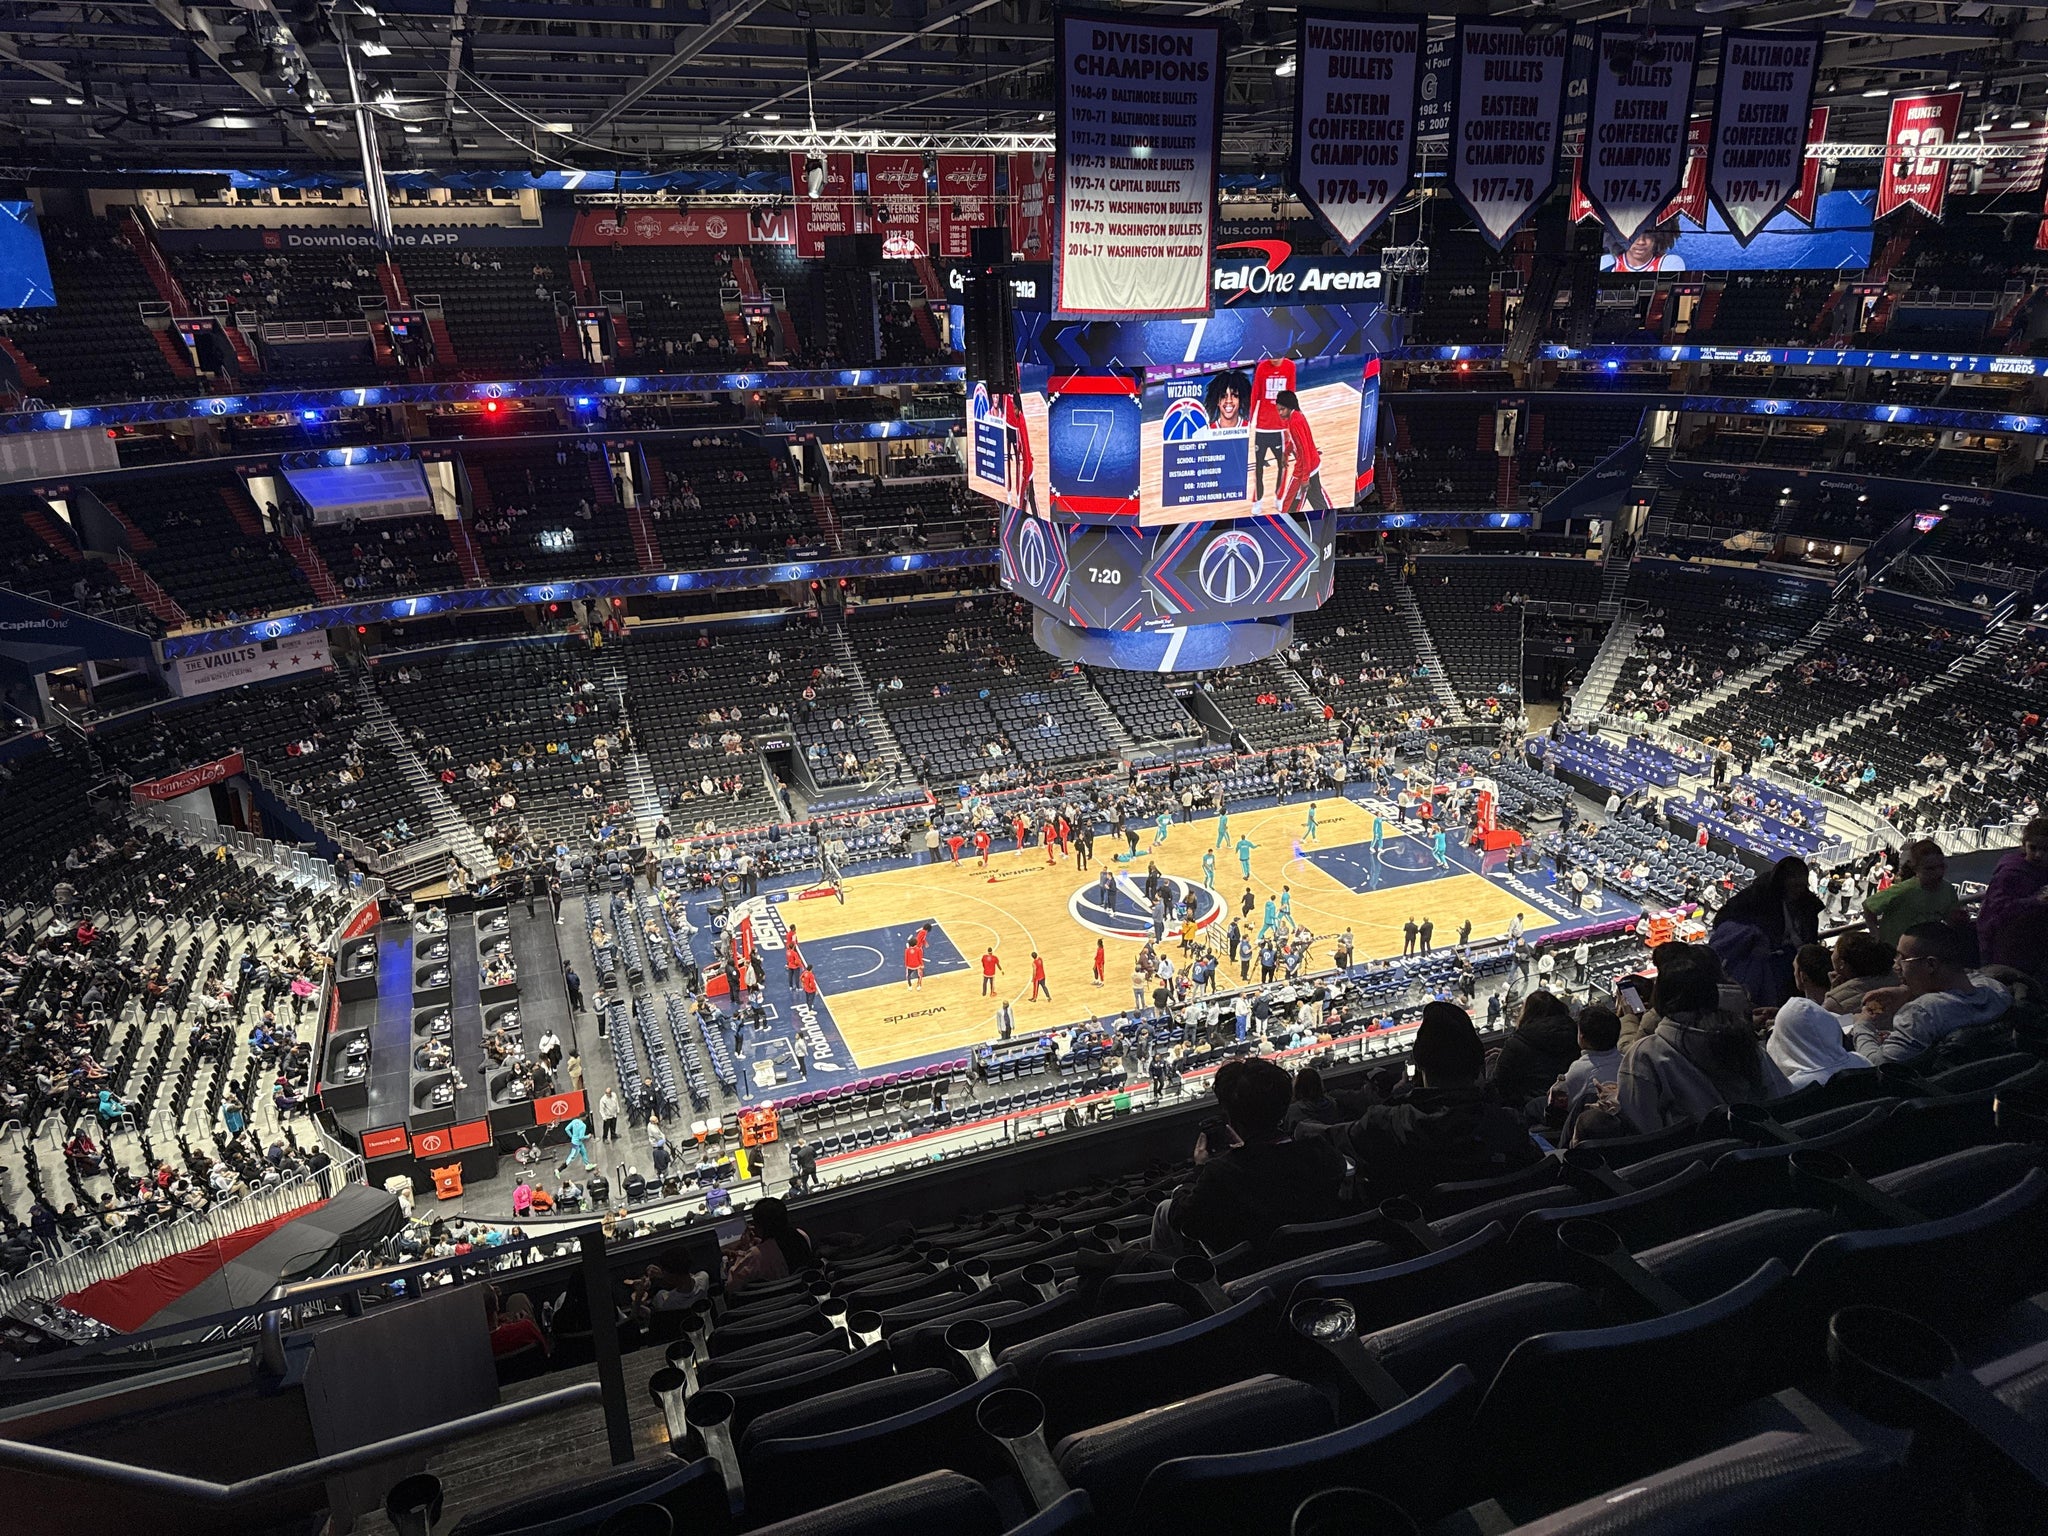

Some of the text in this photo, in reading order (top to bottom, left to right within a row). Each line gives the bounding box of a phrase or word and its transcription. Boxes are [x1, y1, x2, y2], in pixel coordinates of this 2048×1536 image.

[1092, 30, 1193, 57] DIVISION
[1307, 25, 1417, 53] WASHINGTON
[1427, 41, 1444, 55] CAA
[1465, 32, 1565, 57] WASHINGTON
[1731, 44, 1811, 67] WASHINGTON
[1074, 54, 1209, 81] CHAMPIONS
[1328, 56, 1393, 80] BULLETS
[1484, 60, 1543, 82] BULLETS
[1742, 70, 1794, 92] BULLETS
[1071, 84, 1197, 105] 1968-69 BALTIMORE BULLETS
[1326, 92, 1390, 115] EASTERN
[1419, 102, 1438, 116] 1982
[1481, 95, 1538, 116] EASTERN
[1614, 100, 1668, 121] EASTERN
[1738, 103, 1789, 123] EASTERN
[1907, 105, 1942, 120] HUNTER
[1071, 107, 1197, 127] 1970-71 BALTIMORE BULLETS
[1430, 116, 1450, 130] 2007
[1308, 118, 1404, 140] CONFERENCE
[1465, 120, 1551, 142] CONFERENCE
[1599, 123, 1679, 144] CONFERENCE
[1723, 126, 1798, 145] CONFERENCE
[1071, 130, 1196, 149] 1971-72 BALTIMORE BULLETS
[1311, 143, 1398, 166] CHAMPIONS
[1466, 144, 1545, 165] CHAMPIONS
[1600, 147, 1672, 167] CHAMPIONS
[1723, 149, 1791, 168] CHAMPIONS
[1892, 126, 1945, 177] 32
[1071, 153, 1195, 171] 1972-73 BALTIMORE BULLETS
[561, 170, 587, 190] 7
[1070, 176, 1180, 193] 1973-74 CAPITAL BULLETS
[1318, 179, 1388, 204] 1978-79
[1472, 179, 1534, 202] 1977-78
[1603, 179, 1661, 202] 1974-75
[1725, 180, 1780, 202] 1970-71
[811, 203, 839, 212] PATRICK
[1070, 199, 1105, 213] 1974-75
[1109, 201, 1167, 214] WASHINGTON
[1169, 202, 1202, 214] BULLETS
[811, 212, 841, 221] DIVISION
[887, 213, 919, 224] AMPIONS
[807, 222, 846, 232] CHAMPIONS
[1070, 221, 1202, 236] 1978-79 WASHINGTON BULLETS
[1217, 225, 1273, 236] lus.com
[393, 234, 416, 246] he
[420, 233, 460, 246] APP
[1068, 243, 1203, 258] 2016-17 WASHINGTON WIZARDS
[1298, 268, 1382, 291] Arena
[1181, 318, 1209, 362] 7
[1450, 345, 1461, 361] 7
[1672, 346, 1682, 361] 7
[1744, 353, 1772, 363] $2,200
[1950, 362, 1956, 370] 0
[1969, 363, 1976, 371] 7
[1989, 362, 2036, 374] WIZARDS
[616, 378, 627, 394] 7
[850, 370, 861, 386] 7
[354, 389, 367, 406] 7
[1167, 385, 1203, 398] WIZARDS
[59, 409, 73, 430] 7
[1888, 406, 1901, 422] 7
[880, 422, 891, 438] 7
[1072, 409, 1114, 482] 7
[341, 448, 353, 466] 7
[1176, 454, 1225, 465] SCHOOL: PITTSBURGH
[1500, 513, 1510, 528] 7
[901, 555, 912, 571] 7
[668, 575, 680, 591] 7
[1088, 567, 1121, 585] 7:20
[405, 598, 417, 616] 7
[1154, 625, 1188, 672] 7
[185, 648, 256, 671] THE VAULTS
[760, 742, 790, 750] VAULTS
[150, 764, 226, 796] Hennessy Lofts
[1505, 879, 1582, 920] Robinhood
[884, 1006, 947, 1025] wizards
[790, 1004, 834, 1060] Robinhood
